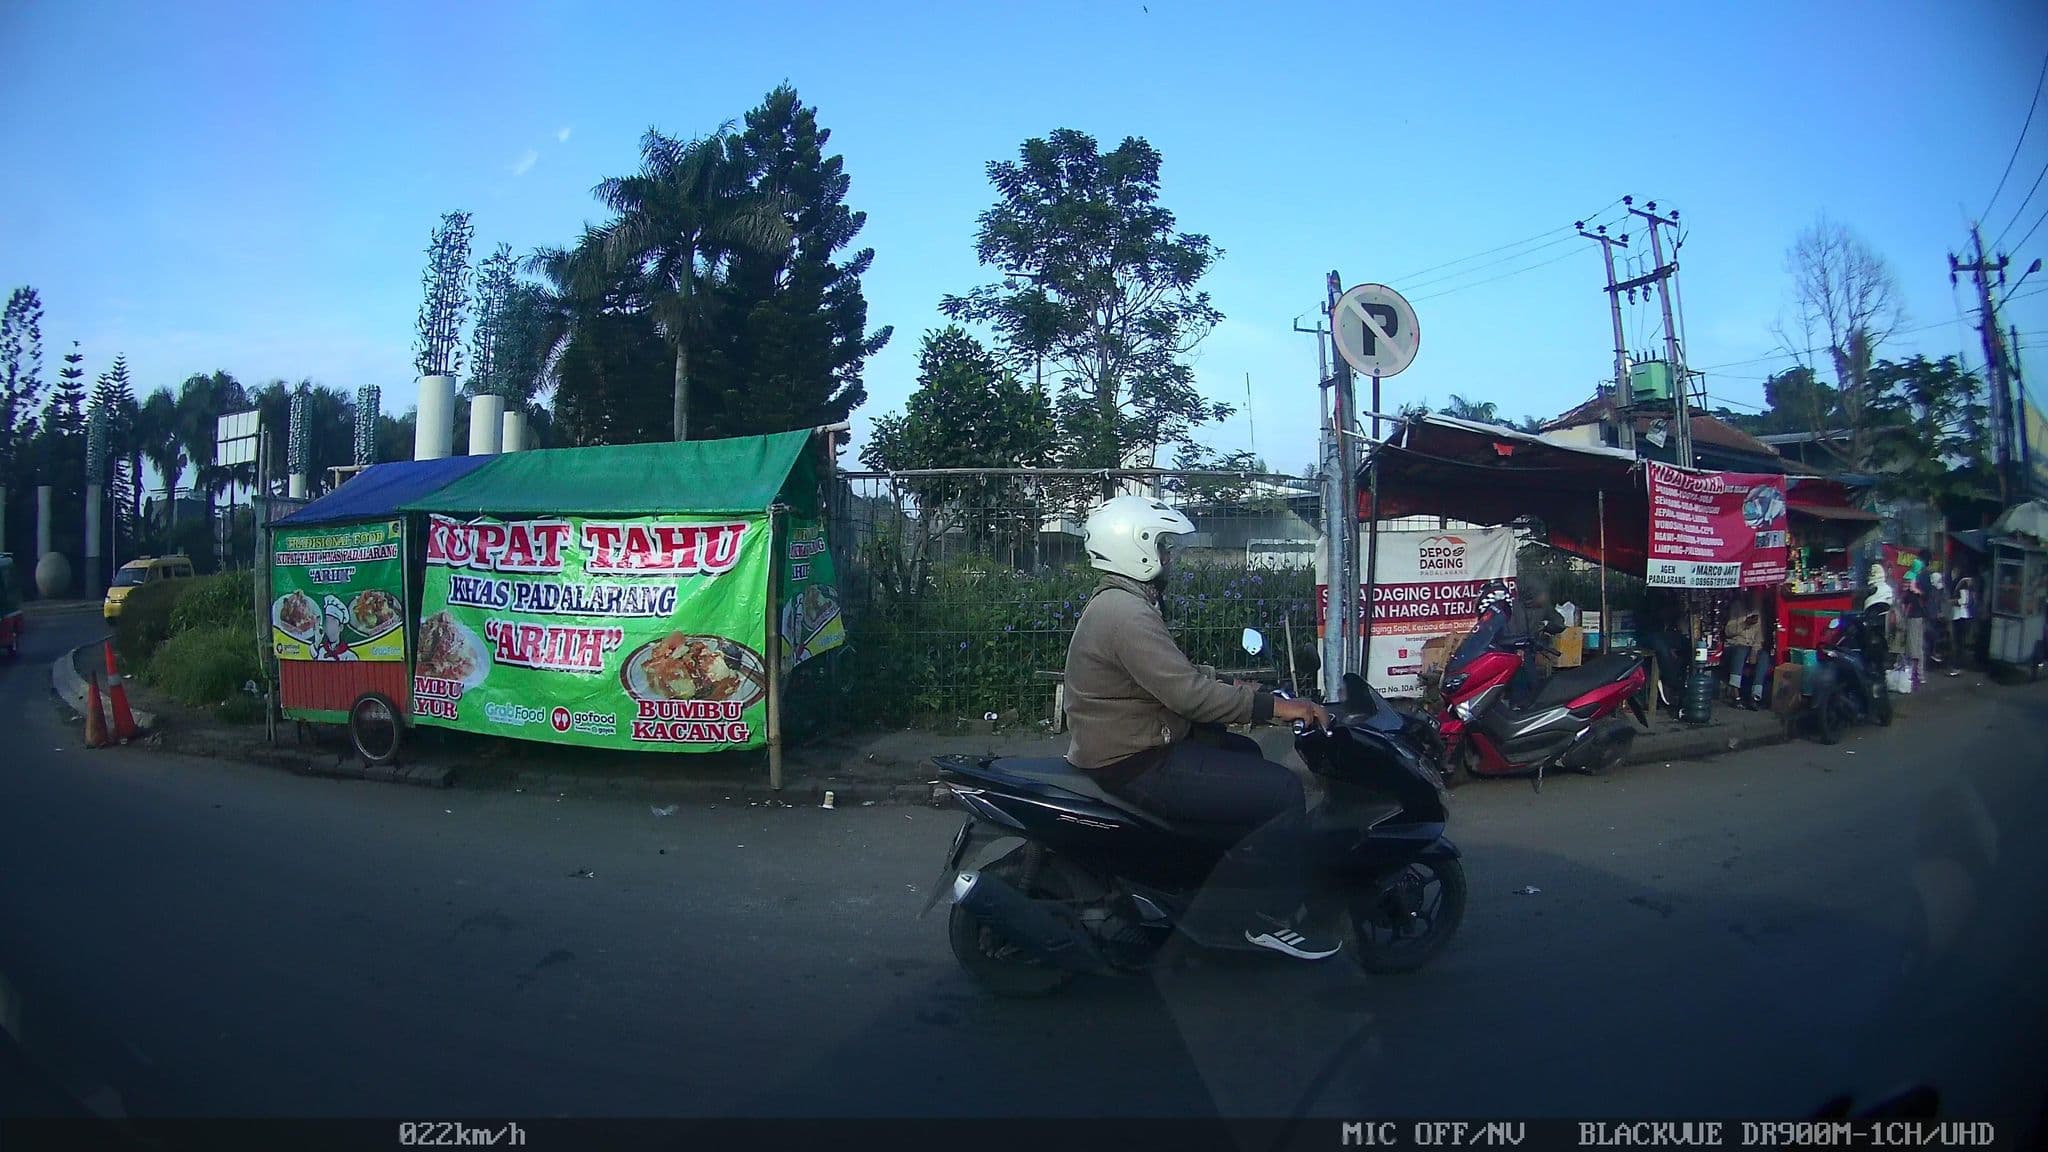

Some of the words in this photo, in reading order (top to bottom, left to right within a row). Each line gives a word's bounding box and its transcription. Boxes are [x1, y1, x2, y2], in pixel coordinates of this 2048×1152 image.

[1361, 303, 1398, 356] P
[354, 531, 384, 546] FOOD
[300, 551, 320, 565] TAHU
[342, 544, 397, 562] PADALARANG
[584, 523, 747, 572] TAHU
[1420, 548, 1451, 557] DEPO
[1420, 559, 1463, 569] DAGING
[1661, 565, 1675, 573] AGEN
[1696, 565, 1722, 576] MARCO
[1648, 575, 1686, 585] PADALARANG
[450, 575, 509, 607] KHAS
[514, 582, 676, 616] PADALARANG
[1373, 586, 1431, 601] DAGING
[1434, 584, 1476, 600] LOKAL
[1389, 603, 1439, 617] HARGA
[1443, 601, 1475, 615] TERJ
[1371, 625, 1392, 634] aging
[413, 697, 457, 719] YUR
[486, 703, 545, 722] GrabFood
[637, 699, 742, 719] BUMBU
[575, 714, 615, 724] gofood
[632, 721, 748, 741] KACANG
